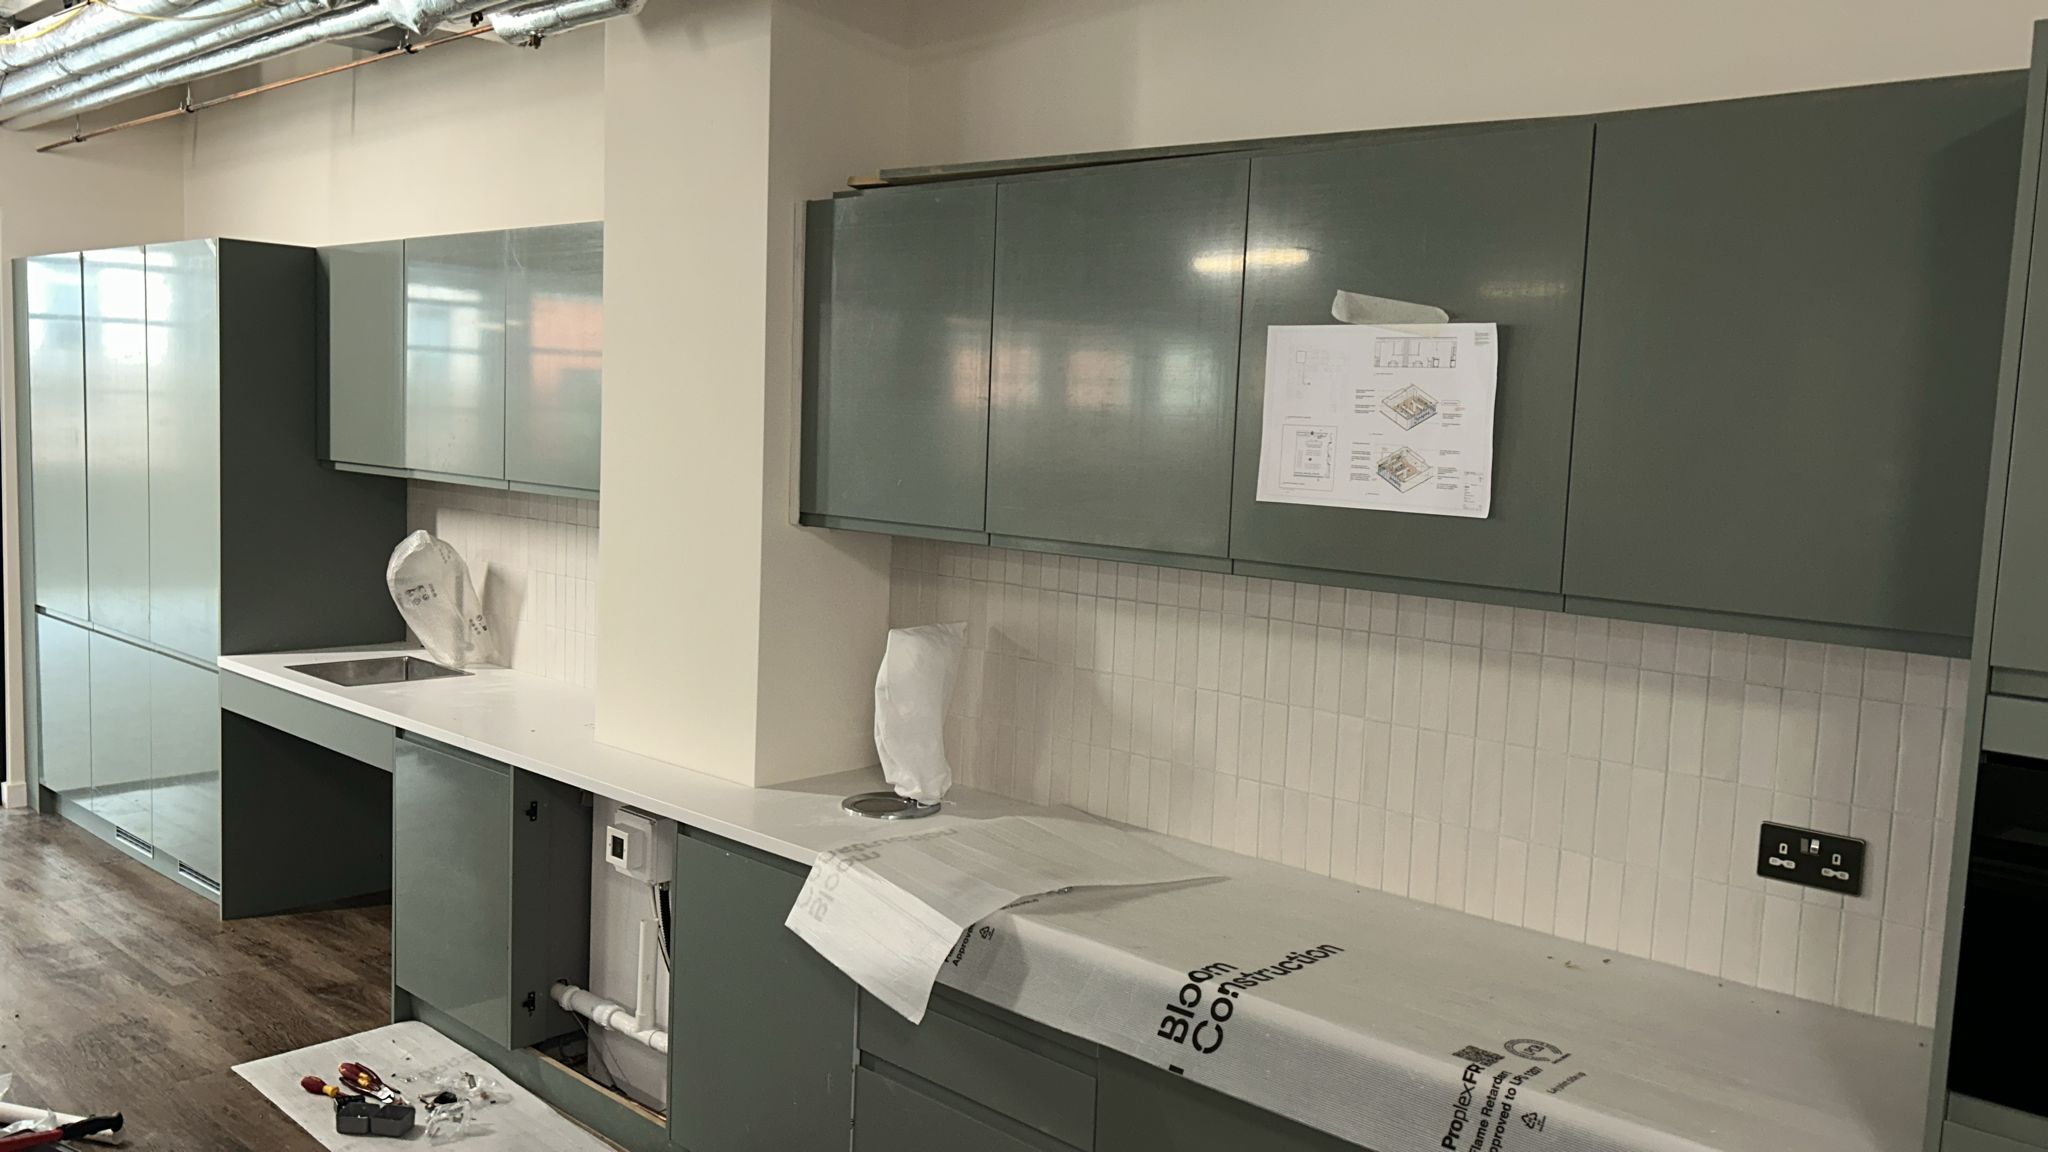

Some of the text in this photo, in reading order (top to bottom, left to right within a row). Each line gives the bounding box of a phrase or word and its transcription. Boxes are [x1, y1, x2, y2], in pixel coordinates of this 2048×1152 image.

[1157, 962, 1238, 1044] Bloom
[1192, 944, 1345, 1054] Construction
[1490, 1102, 1512, 1152] pproved
[1504, 1087, 1517, 1100] to
